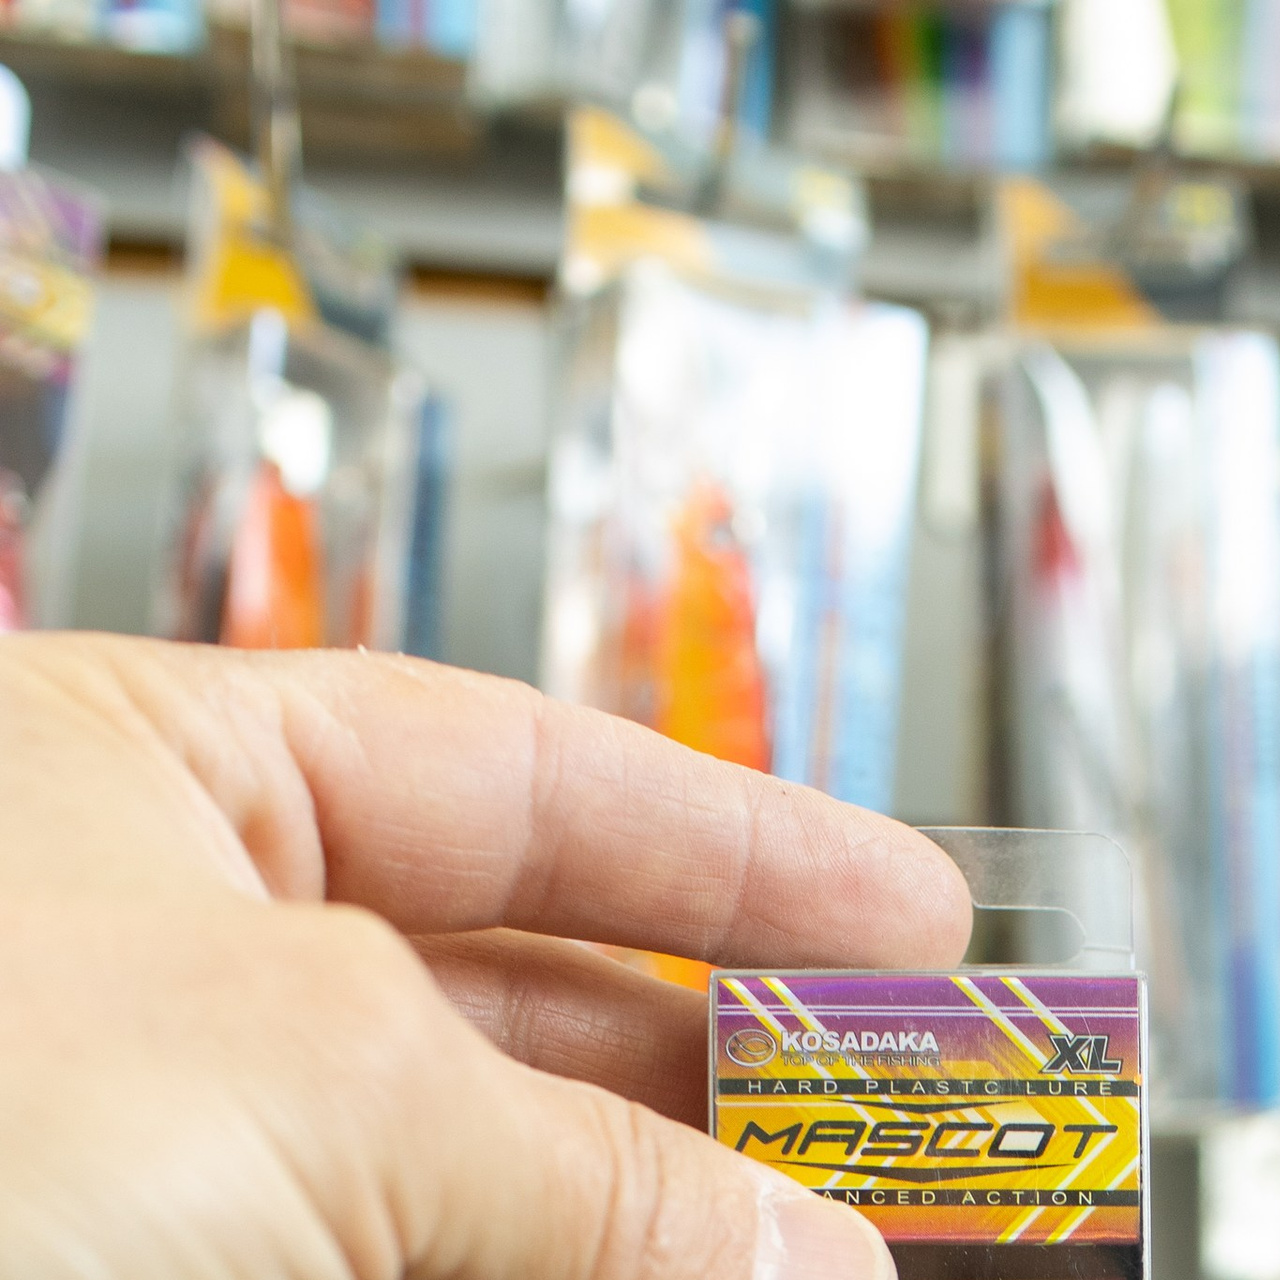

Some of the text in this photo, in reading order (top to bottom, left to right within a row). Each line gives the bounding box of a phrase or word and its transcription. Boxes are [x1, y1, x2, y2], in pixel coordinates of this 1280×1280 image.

[781, 1030, 940, 1052] KOSADAKA
[781, 1055, 941, 1067] TOP OF THE FISHING
[1041, 1034, 1123, 1074] XL
[747, 1079, 839, 1094] HARD
[1025, 1080, 1113, 1096] LURE
[735, 1120, 1118, 1158] MASCOT
[961, 1190, 1095, 1206] ACTION
